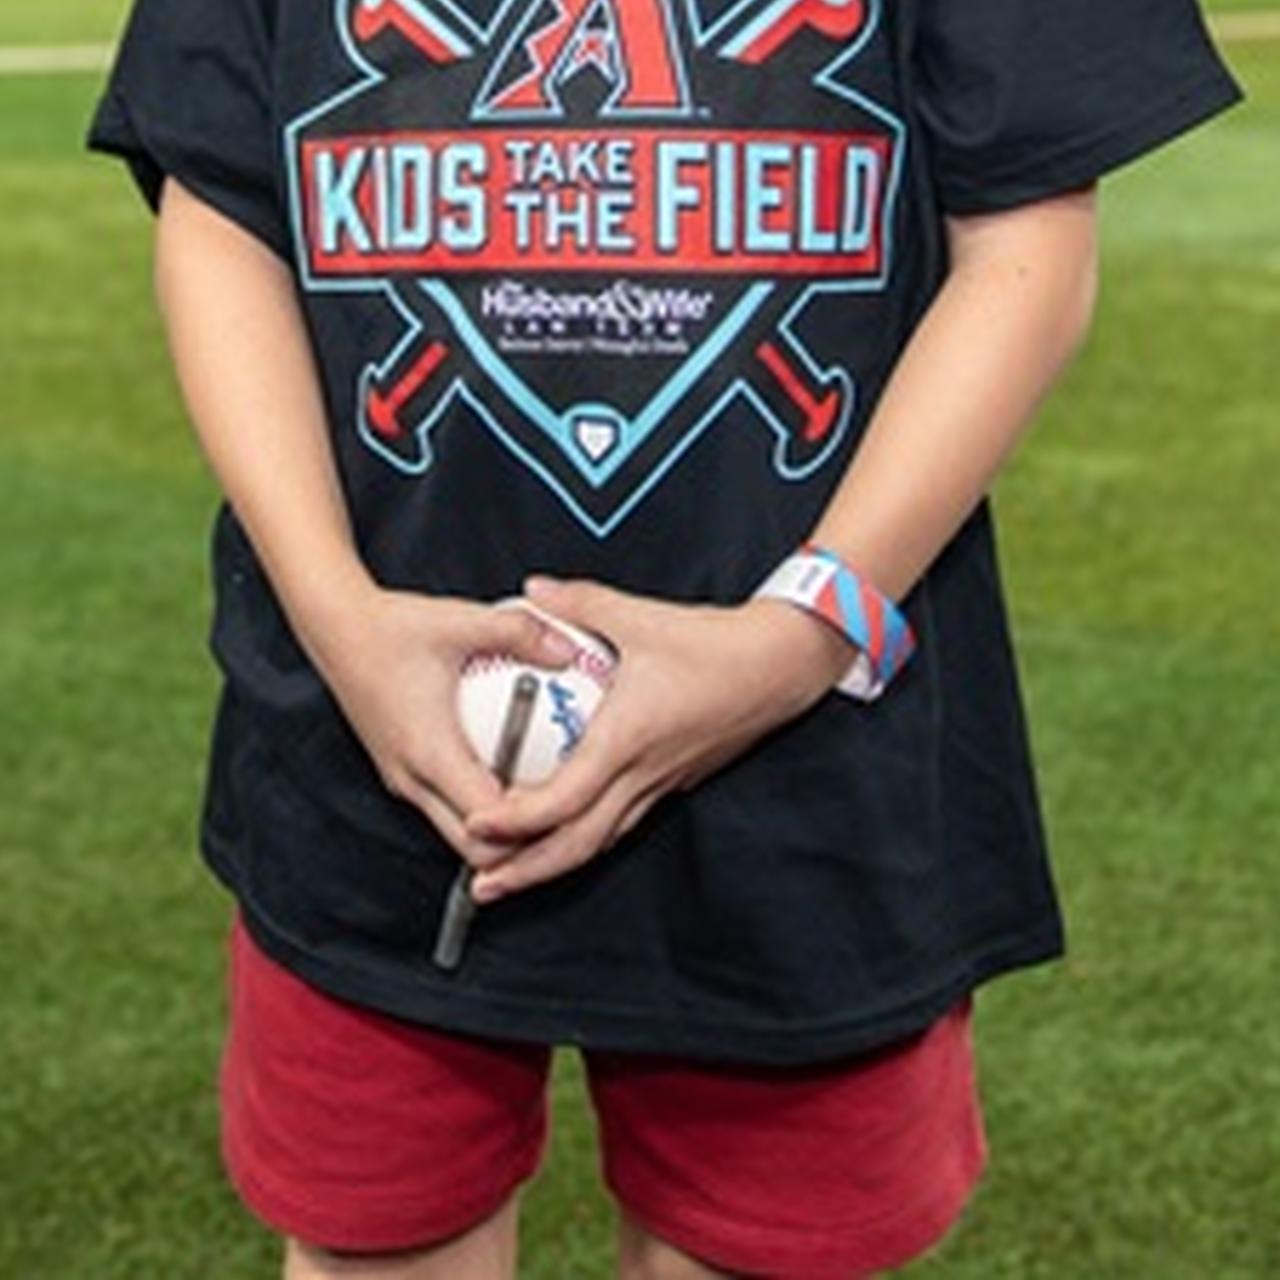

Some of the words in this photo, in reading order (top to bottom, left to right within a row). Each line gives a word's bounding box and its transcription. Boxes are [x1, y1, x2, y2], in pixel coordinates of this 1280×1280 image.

[313, 141, 487, 254] KIDS
[504, 140, 634, 184] TAKE
[656, 140, 882, 253] FIELD
[504, 191, 636, 250] THE
